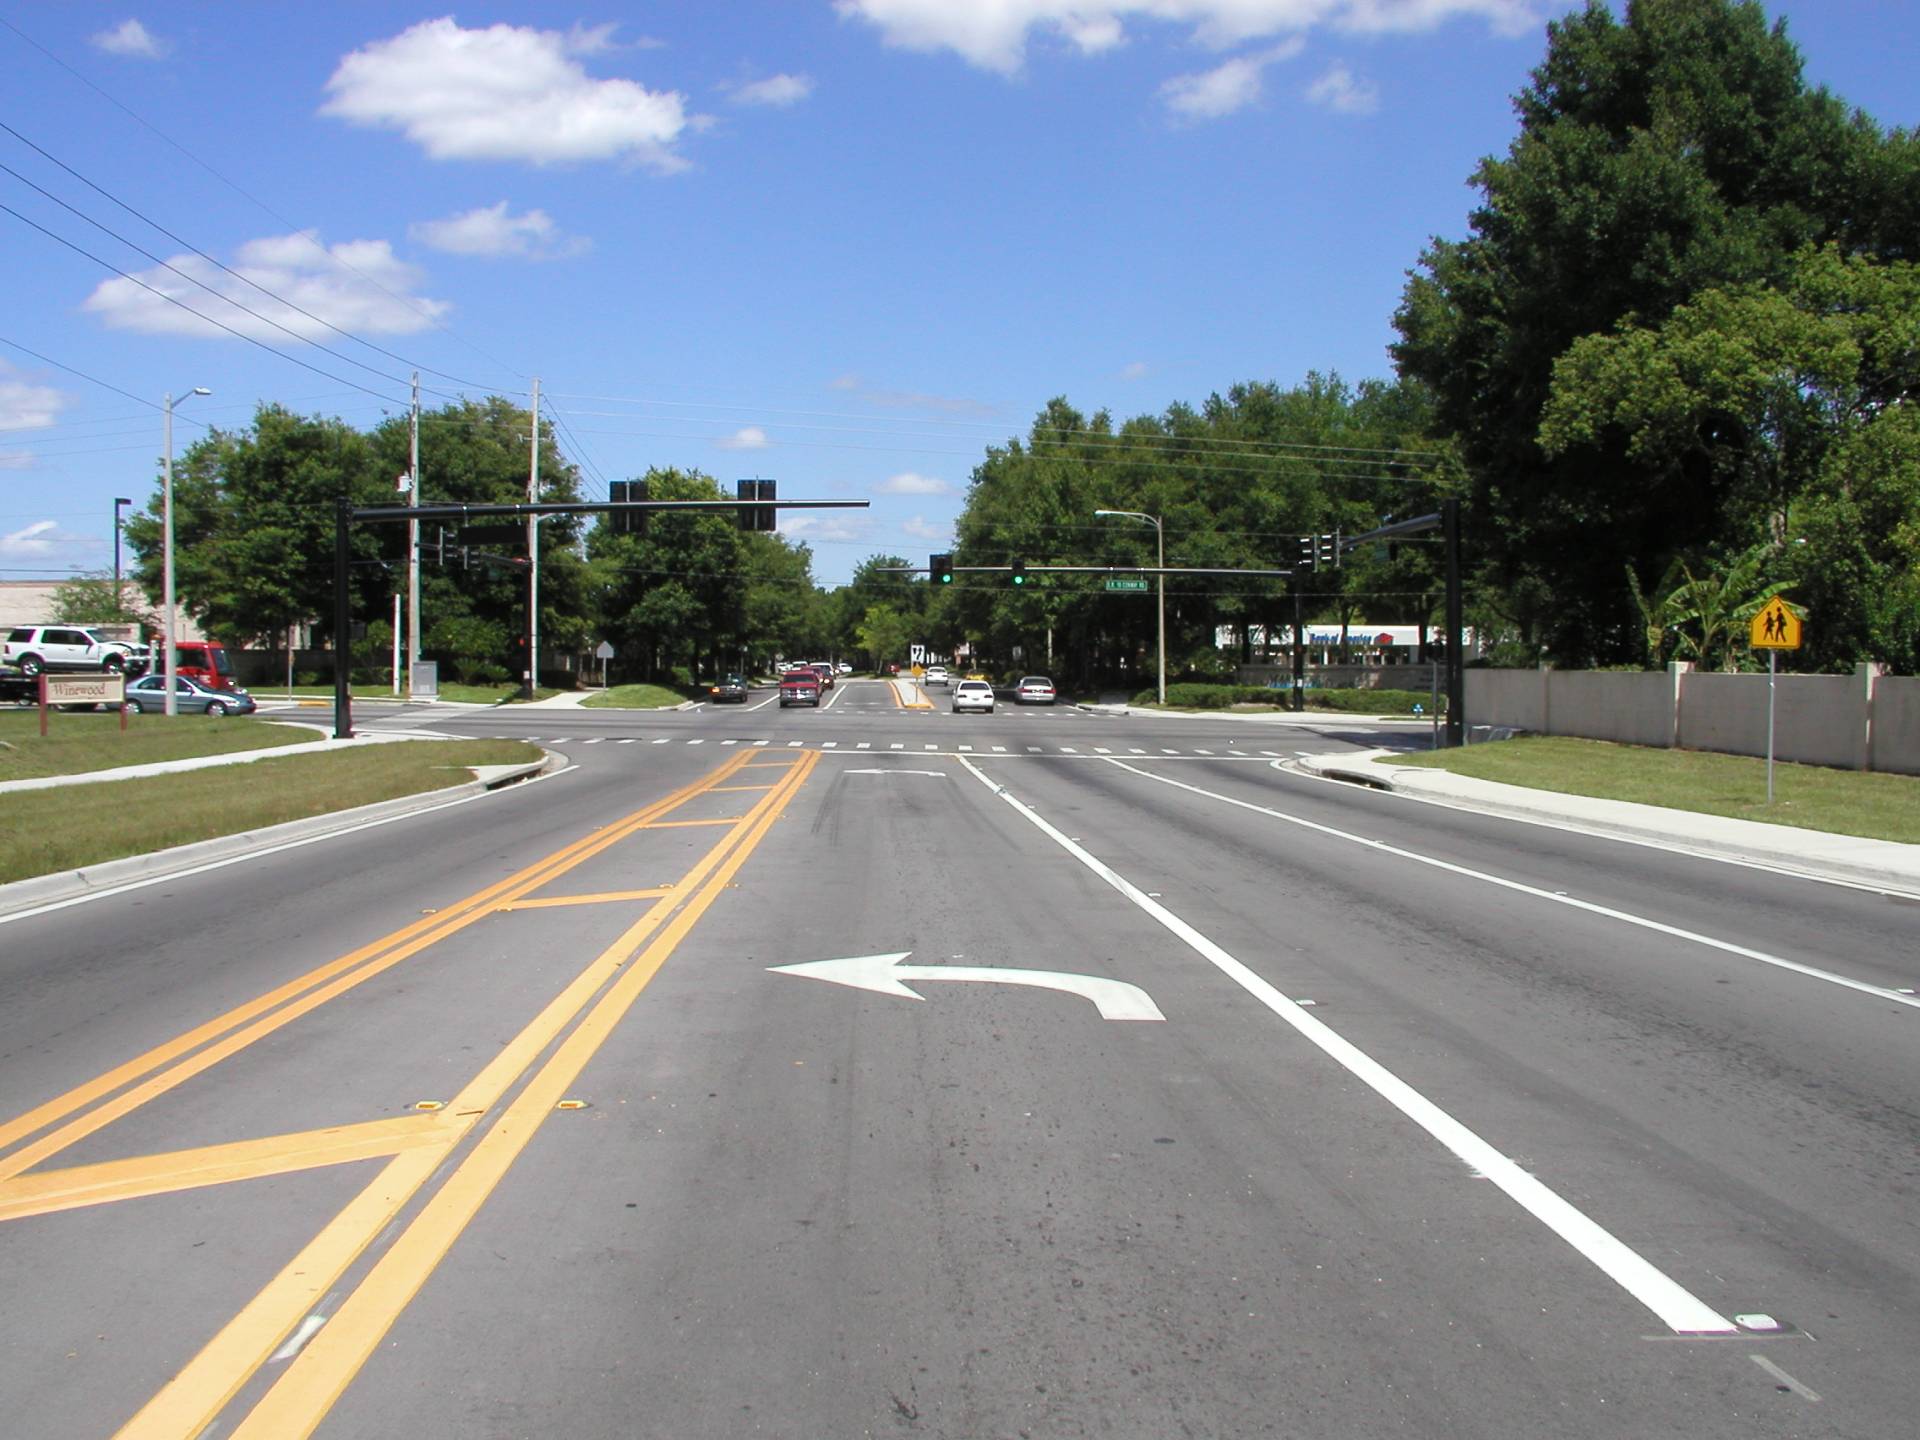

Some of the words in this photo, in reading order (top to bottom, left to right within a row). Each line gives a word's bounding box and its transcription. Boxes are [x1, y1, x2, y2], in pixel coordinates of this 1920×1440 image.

[1309, 633, 1329, 642] Bank
[1342, 633, 1372, 642] merica
[53, 682, 105, 697] Winewood
